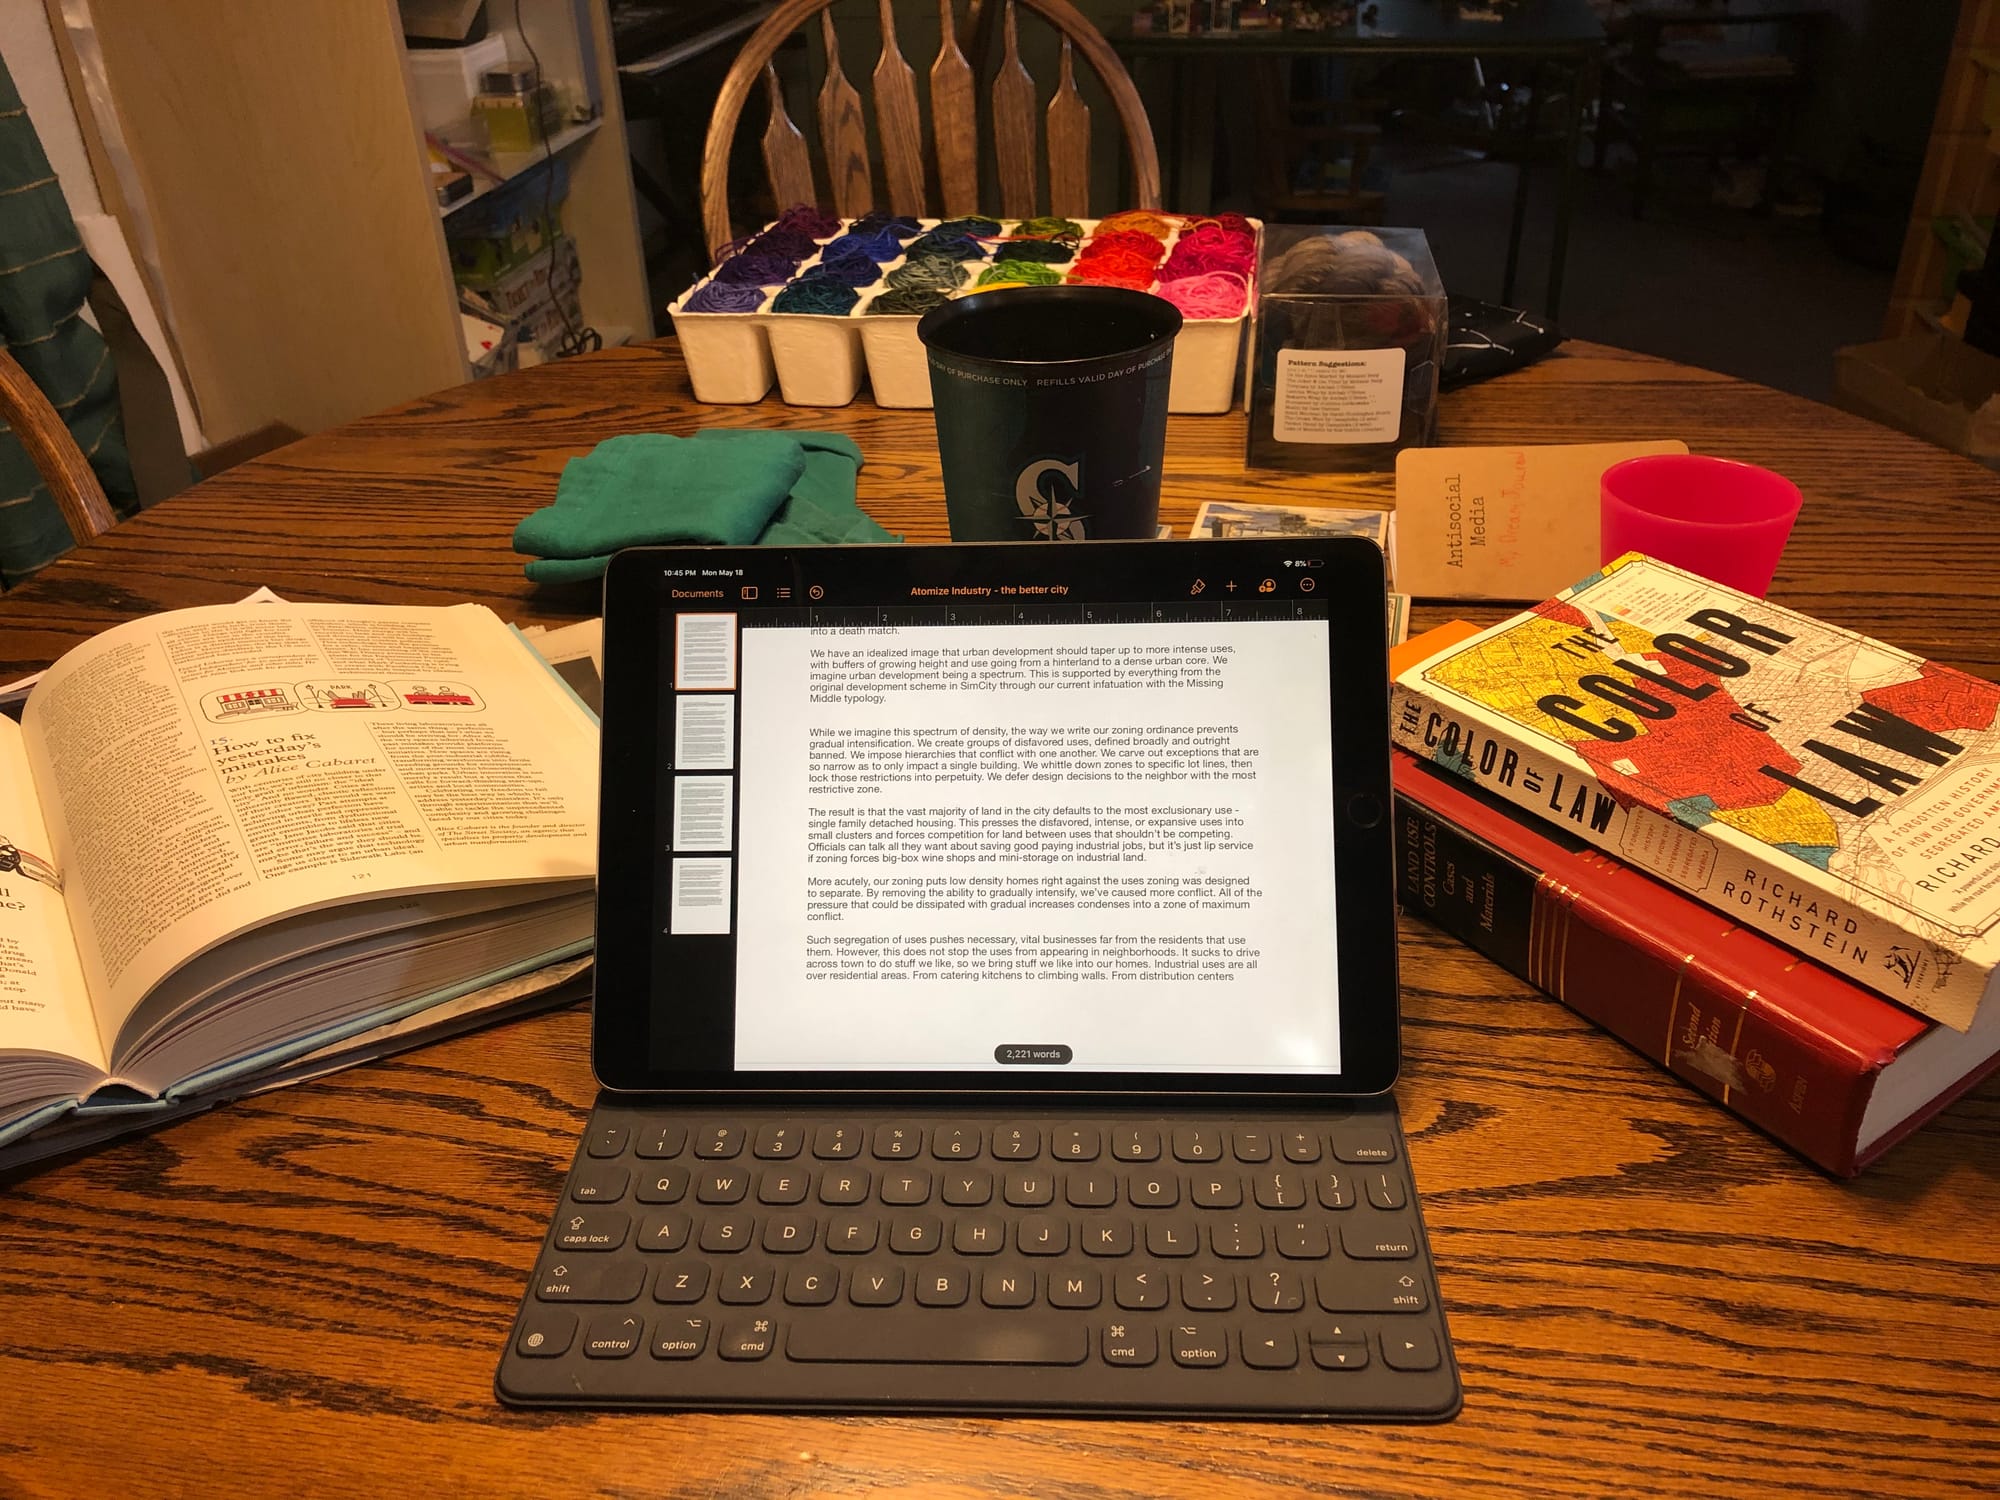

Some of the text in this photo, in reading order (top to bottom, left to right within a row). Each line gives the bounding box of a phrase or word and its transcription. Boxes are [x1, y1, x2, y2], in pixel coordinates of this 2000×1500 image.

[1036, 378, 1076, 387] REFILLS
[1078, 374, 1105, 385] VALID
[1107, 369, 1125, 380] DAY
[1126, 365, 1137, 375] OF
[1287, 359, 1367, 368] Pattern Suggestions:
[957, 370, 1001, 385] PURCHASE
[1003, 378, 1028, 387] ONLY
[1445, 473, 1463, 568] Antisocial
[1469, 496, 1486, 547] Media
[663, 569, 697, 577] 10:45 PM
[702, 569, 718, 577] Mon
[718, 569, 734, 578] May
[671, 589, 725, 599] Documents
[910, 586, 950, 596] Atomize
[951, 586, 992, 597] Industry
[1000, 585, 1017, 595] the
[1018, 585, 1048, 595] better
[1050, 584, 1069, 596] city
[809, 649, 825, 658] We
[827, 649, 850, 657] have
[866, 648, 907, 657] idealized
[910, 648, 939, 658] image
[941, 647, 960, 656] that
[962, 647, 989, 656] urban
[991, 647, 1053, 657] development
[1055, 646, 1088, 655] should
[1090, 646, 1116, 656] taper
[1117, 647, 1130, 656] up
[1132, 646, 1143, 654] to
[1145, 646, 1170, 654] more
[1172, 645, 1207, 653] intense
[1209, 645, 1235, 656] uses,
[1550, 627, 1620, 660] THE
[1536, 608, 1797, 743] COLOR
[1400, 700, 1422, 736] THE
[1731, 702, 1782, 733] OF
[210, 736, 233, 746] 15.
[213, 733, 317, 756] How to fix
[215, 741, 322, 767] yesterday's
[1423, 712, 1519, 788] COLOR
[220, 753, 307, 775] mistakes
[225, 757, 377, 785] by Alice Cabaret
[1758, 701, 1966, 818] LAW
[1523, 766, 1547, 794] OF
[1548, 773, 1617, 835] LAW
[1883, 767, 1993, 844] A FORGOTTEN HISTORY
[1891, 846, 1909, 858] OF
[1906, 830, 1934, 848] HOW
[1931, 817, 1957, 833] OUR
[1919, 817, 1985, 860] SEGREGATED
[264, 870, 286, 880] One
[288, 860, 328, 873] example
[340, 852, 382, 863] Sidewalk
[807, 854, 814, 862] if
[815, 854, 847, 864] zoning
[849, 853, 880, 862] forces
[882, 851, 919, 864] big-box
[921, 853, 944, 862] wine
[946, 853, 976, 864] shops
[977, 853, 996, 862] and
[998, 851, 1059, 864] mini-storage
[1076, 852, 1120, 861] industrial
[1122, 852, 1146, 861] land.
[1406, 816, 1420, 895] LAND USE
[1423, 821, 1438, 909] CONTROLS
[1915, 836, 2000, 892] RICHARD
[1442, 860, 1456, 896] Cases
[1461, 874, 1475, 904] and
[1479, 871, 1496, 934] Materials
[1743, 868, 1858, 935] RICHARD
[1722, 881, 1869, 965] ROTHSTEIN
[1682, 1001, 1702, 1050] Second
[1006, 1049, 1061, 1060] 2,221 words
[1356, 1147, 1388, 1157] delete
[580, 1186, 597, 1196] tab
[656, 1178, 670, 1191] Q
[716, 1178, 733, 1191] W
[778, 1179, 790, 1191] E
[839, 1179, 851, 1192] R
[901, 1179, 913, 1192] T
[962, 1180, 974, 1192] Y
[1023, 1181, 1036, 1193] U
[1210, 1182, 1222, 1195] P
[563, 1233, 610, 1245] caps lock
[657, 1224, 1409, 1252] A S D F G H J K L return
[545, 1274, 1420, 1305] shift Z X C V B N M shift
[591, 1338, 1217, 1360] control option cmd cmd option
